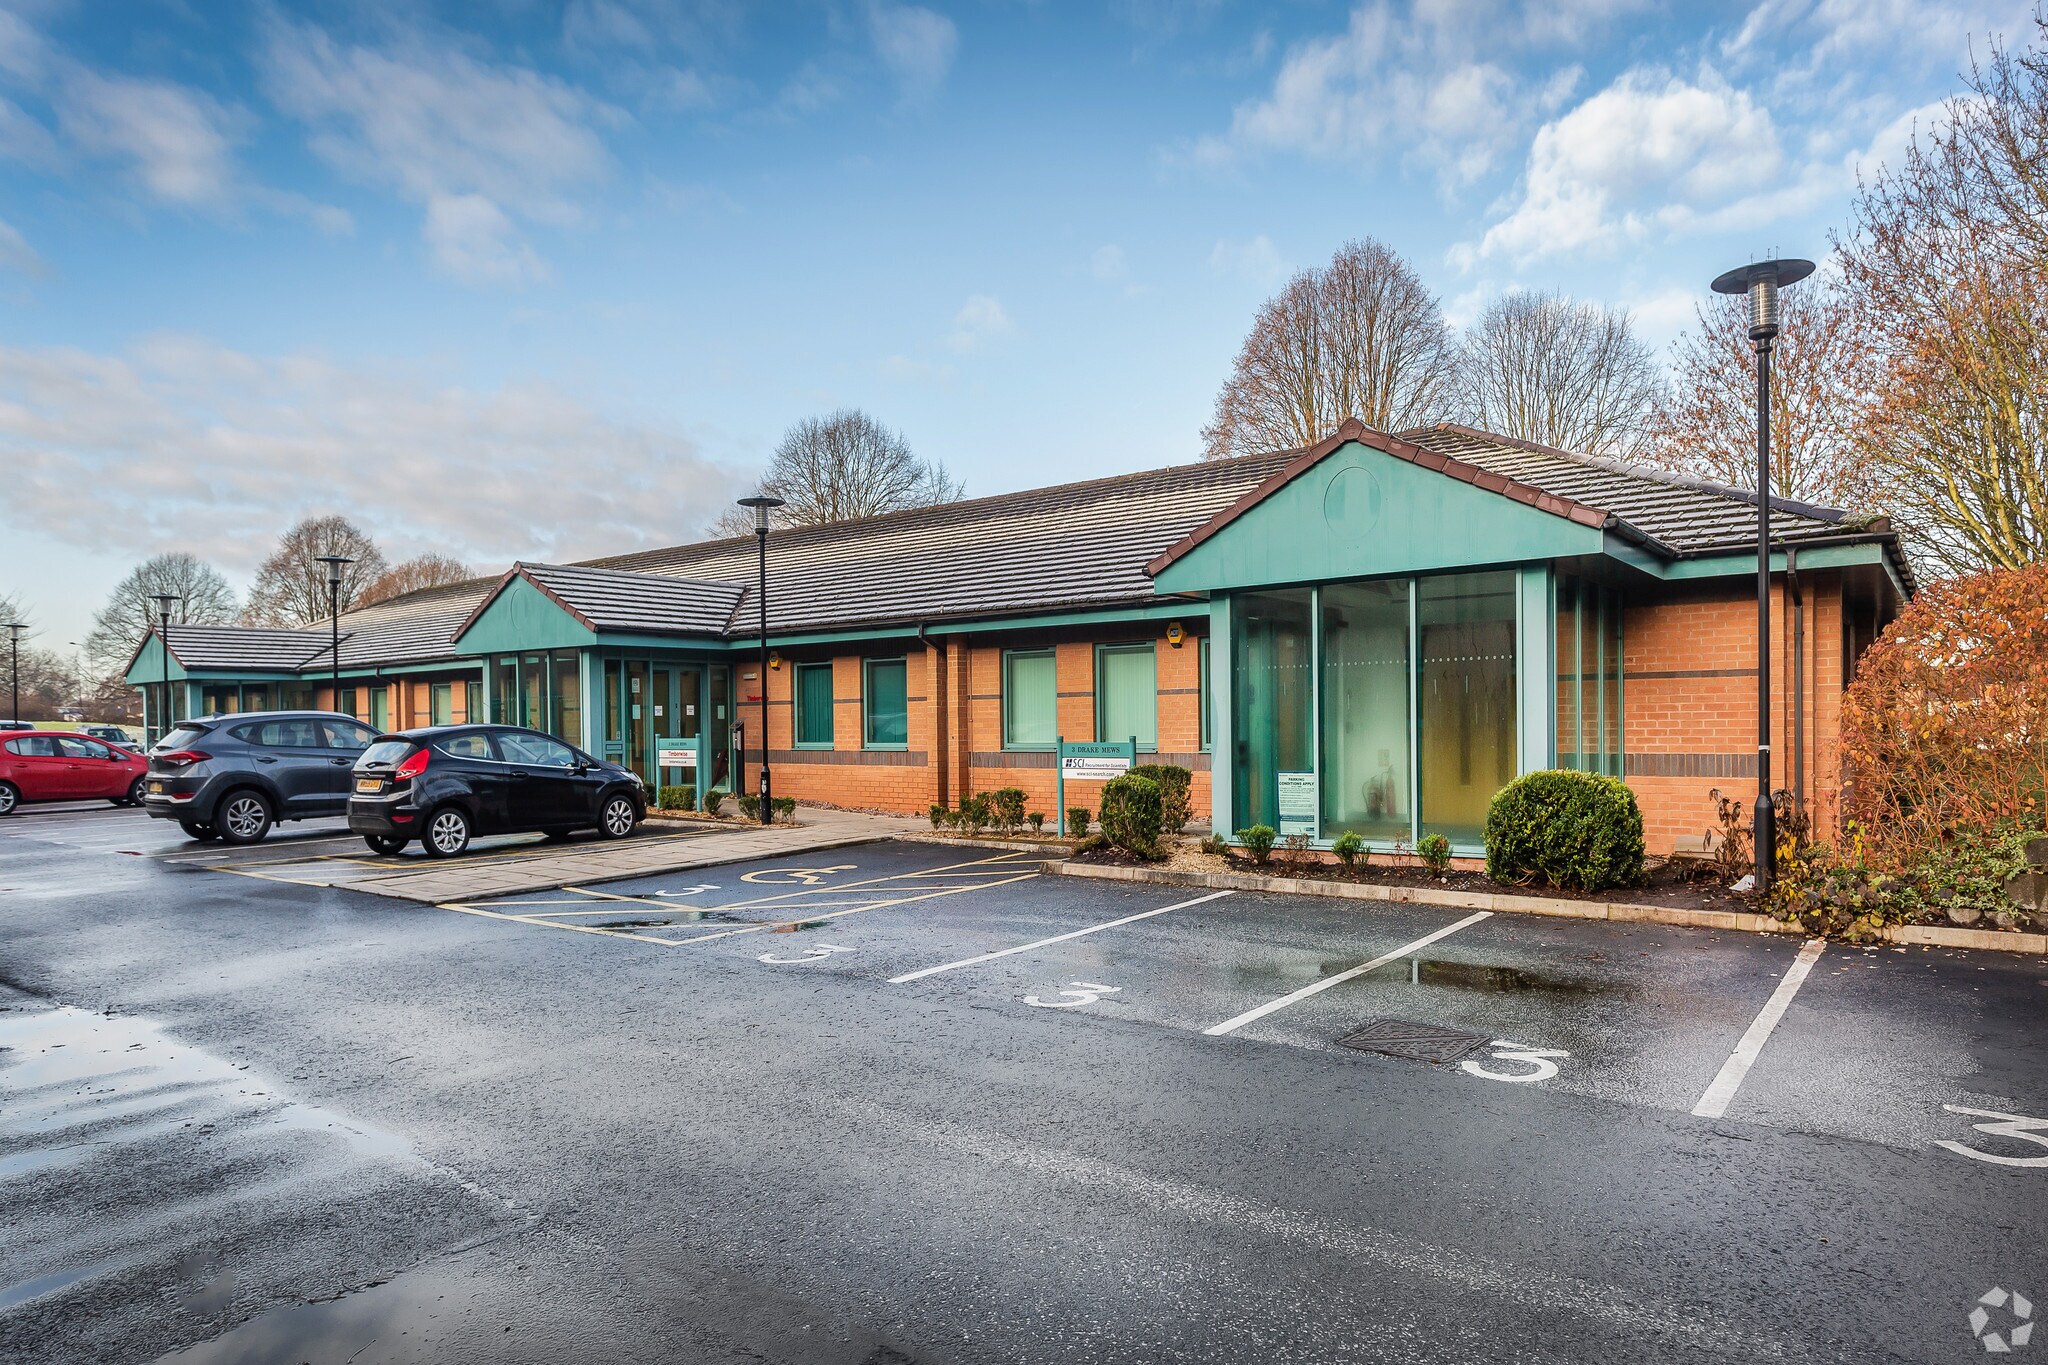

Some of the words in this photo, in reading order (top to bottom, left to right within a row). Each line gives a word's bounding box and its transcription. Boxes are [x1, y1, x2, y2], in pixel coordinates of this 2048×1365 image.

[1073, 758, 1085, 768] SCI
[756, 943, 858, 965] 3
[1023, 981, 1123, 1009] 3
[1461, 1040, 1571, 1082] 3
[1934, 1103, 2048, 1168] 3
